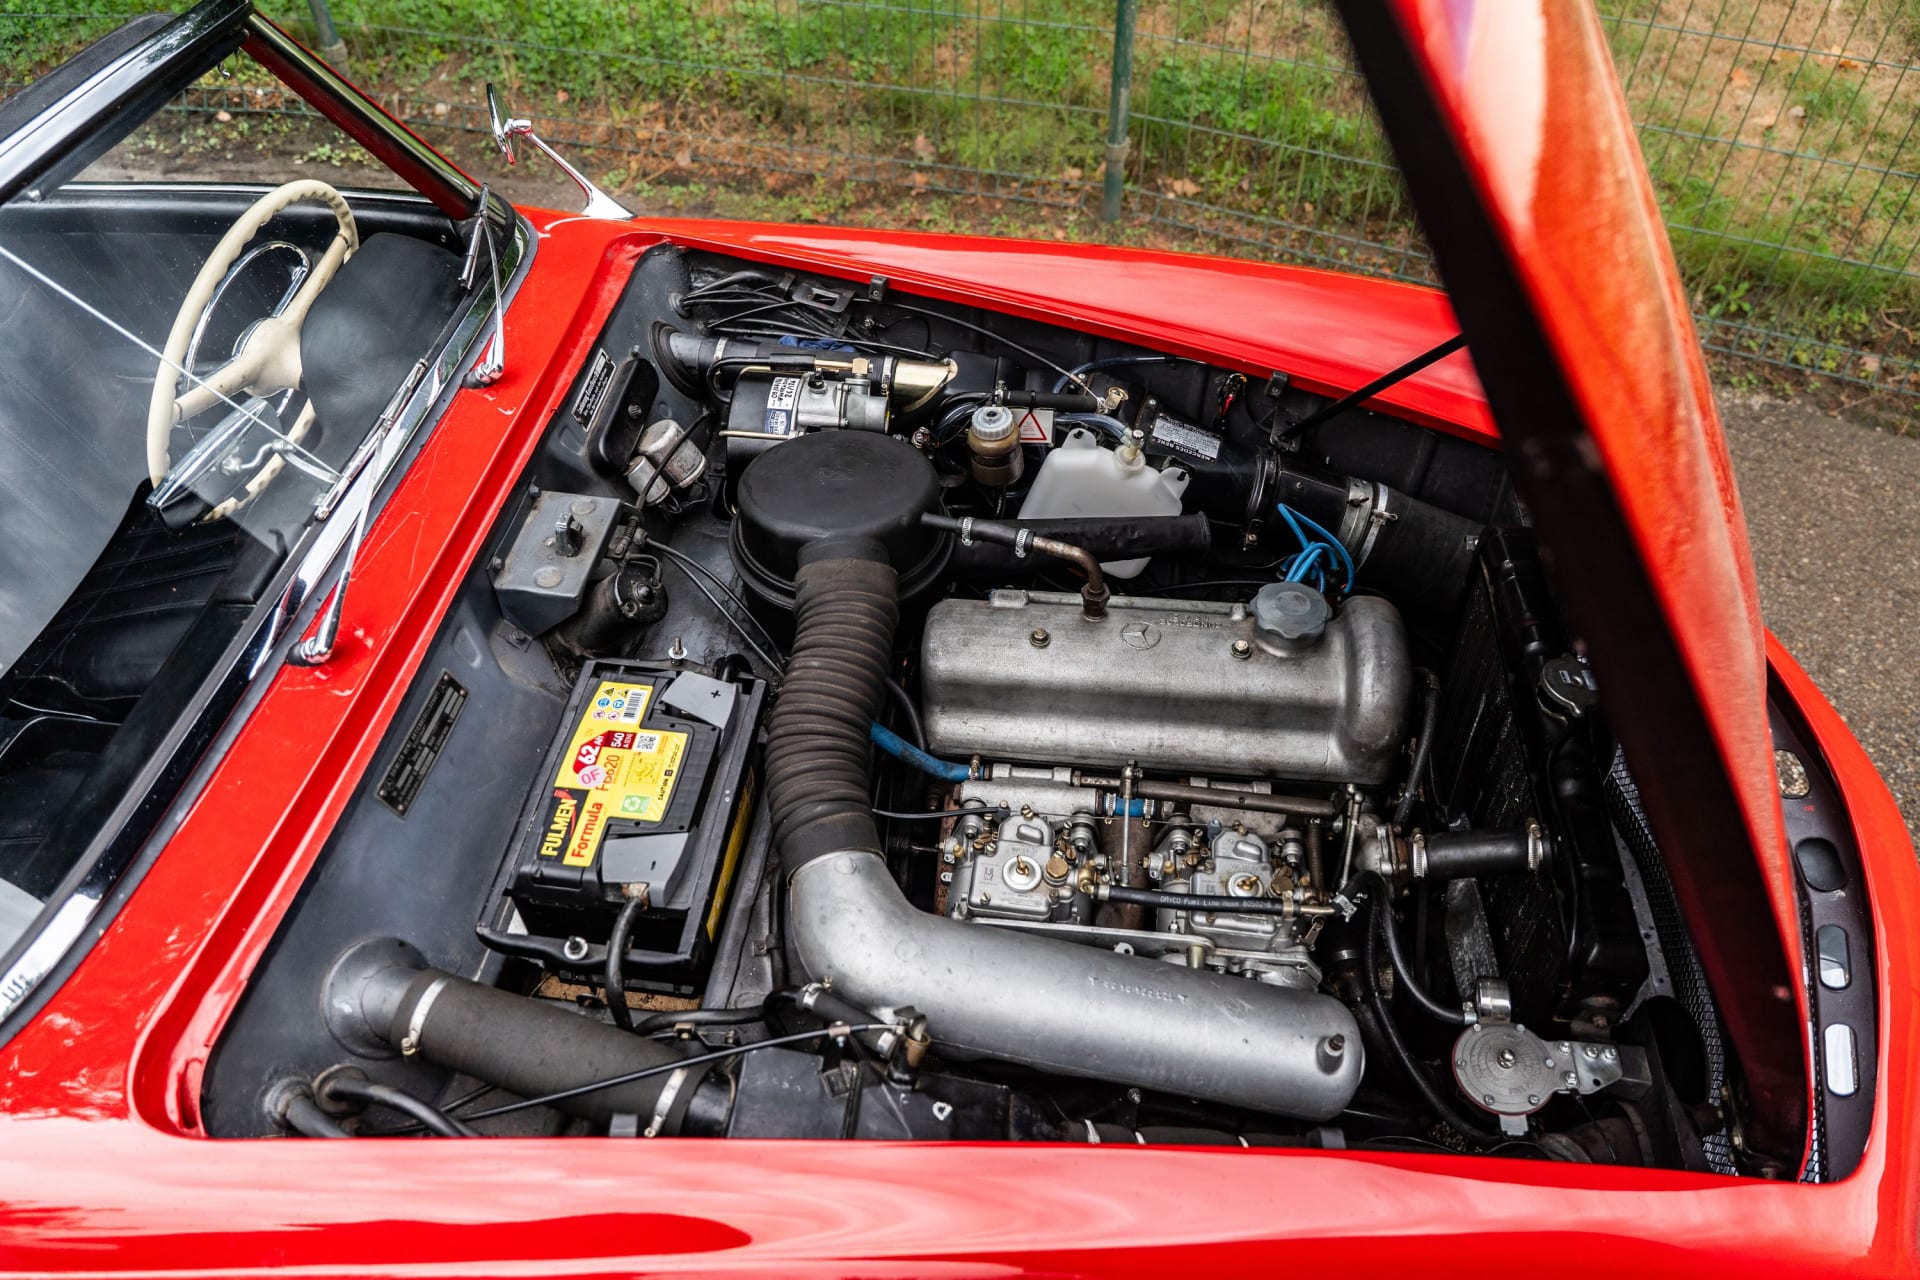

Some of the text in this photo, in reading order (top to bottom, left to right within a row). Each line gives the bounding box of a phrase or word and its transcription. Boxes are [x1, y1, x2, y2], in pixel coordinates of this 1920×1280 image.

[1156, 438, 1212, 462] MERCEDES BENZ
[610, 732, 625, 748] 540
[578, 745, 600, 765] 62
[657, 778, 669, 801] CAUTION
[540, 799, 578, 857] FULMEN
[571, 802, 604, 858] Formula
[1183, 897, 1201, 906] Fuel
